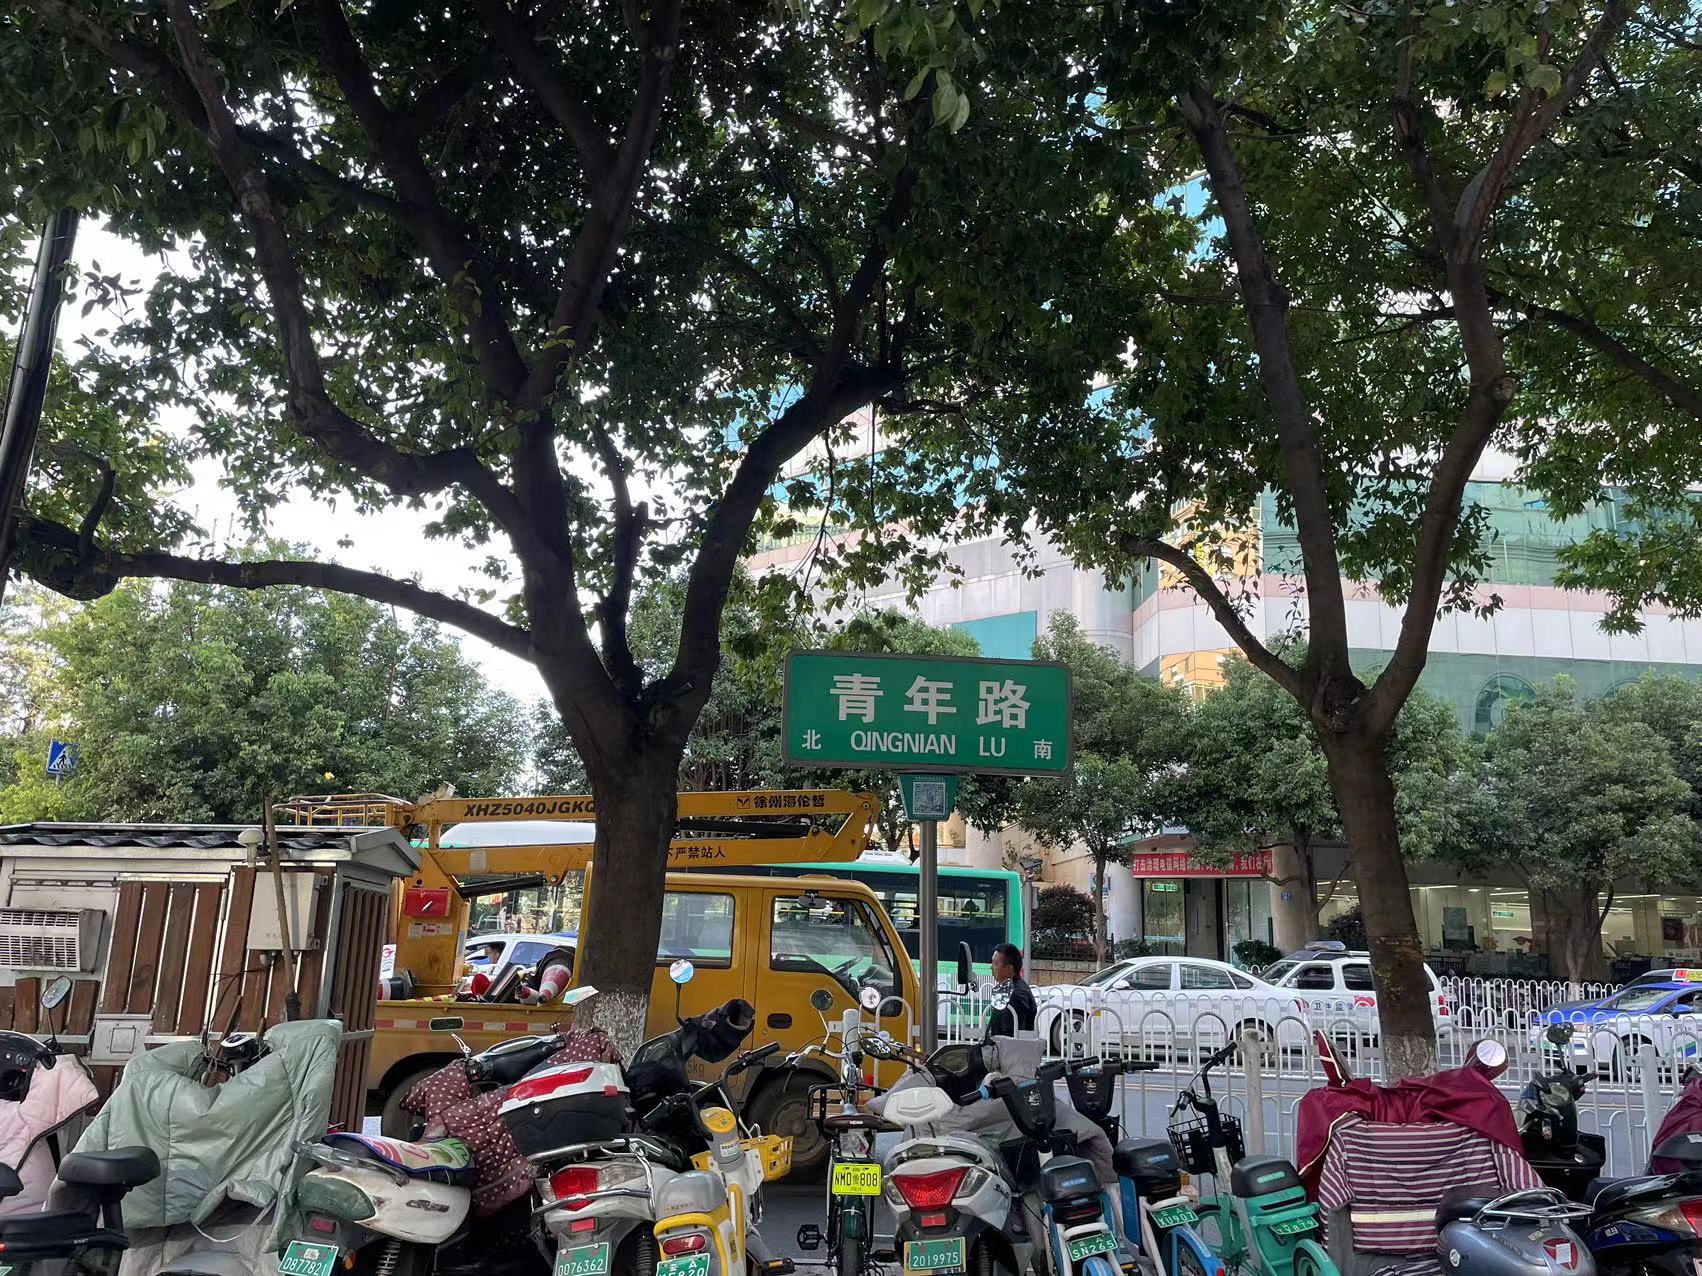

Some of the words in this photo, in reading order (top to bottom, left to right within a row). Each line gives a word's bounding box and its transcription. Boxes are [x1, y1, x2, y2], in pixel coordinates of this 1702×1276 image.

[829, 673, 1031, 729] 青年路
[801, 729, 822, 751] 北
[850, 730, 956, 755] QINGNIAN
[979, 736, 1006, 757] LU
[1033, 739, 1053, 760] 南
[464, 800, 598, 817] XHZ5040JGKQ
[753, 794, 825, 809] 徐州海伦哲
[834, 1172, 852, 1186] NMD
[860, 1172, 878, 1187] 808
[1158, 1211, 1194, 1227] XU907
[1072, 1240, 1115, 1259] SN265
[558, 1258, 604, 1276] 0076362
[688, 1261, 697, 1269] A
[912, 1251, 959, 1267] 2019975
